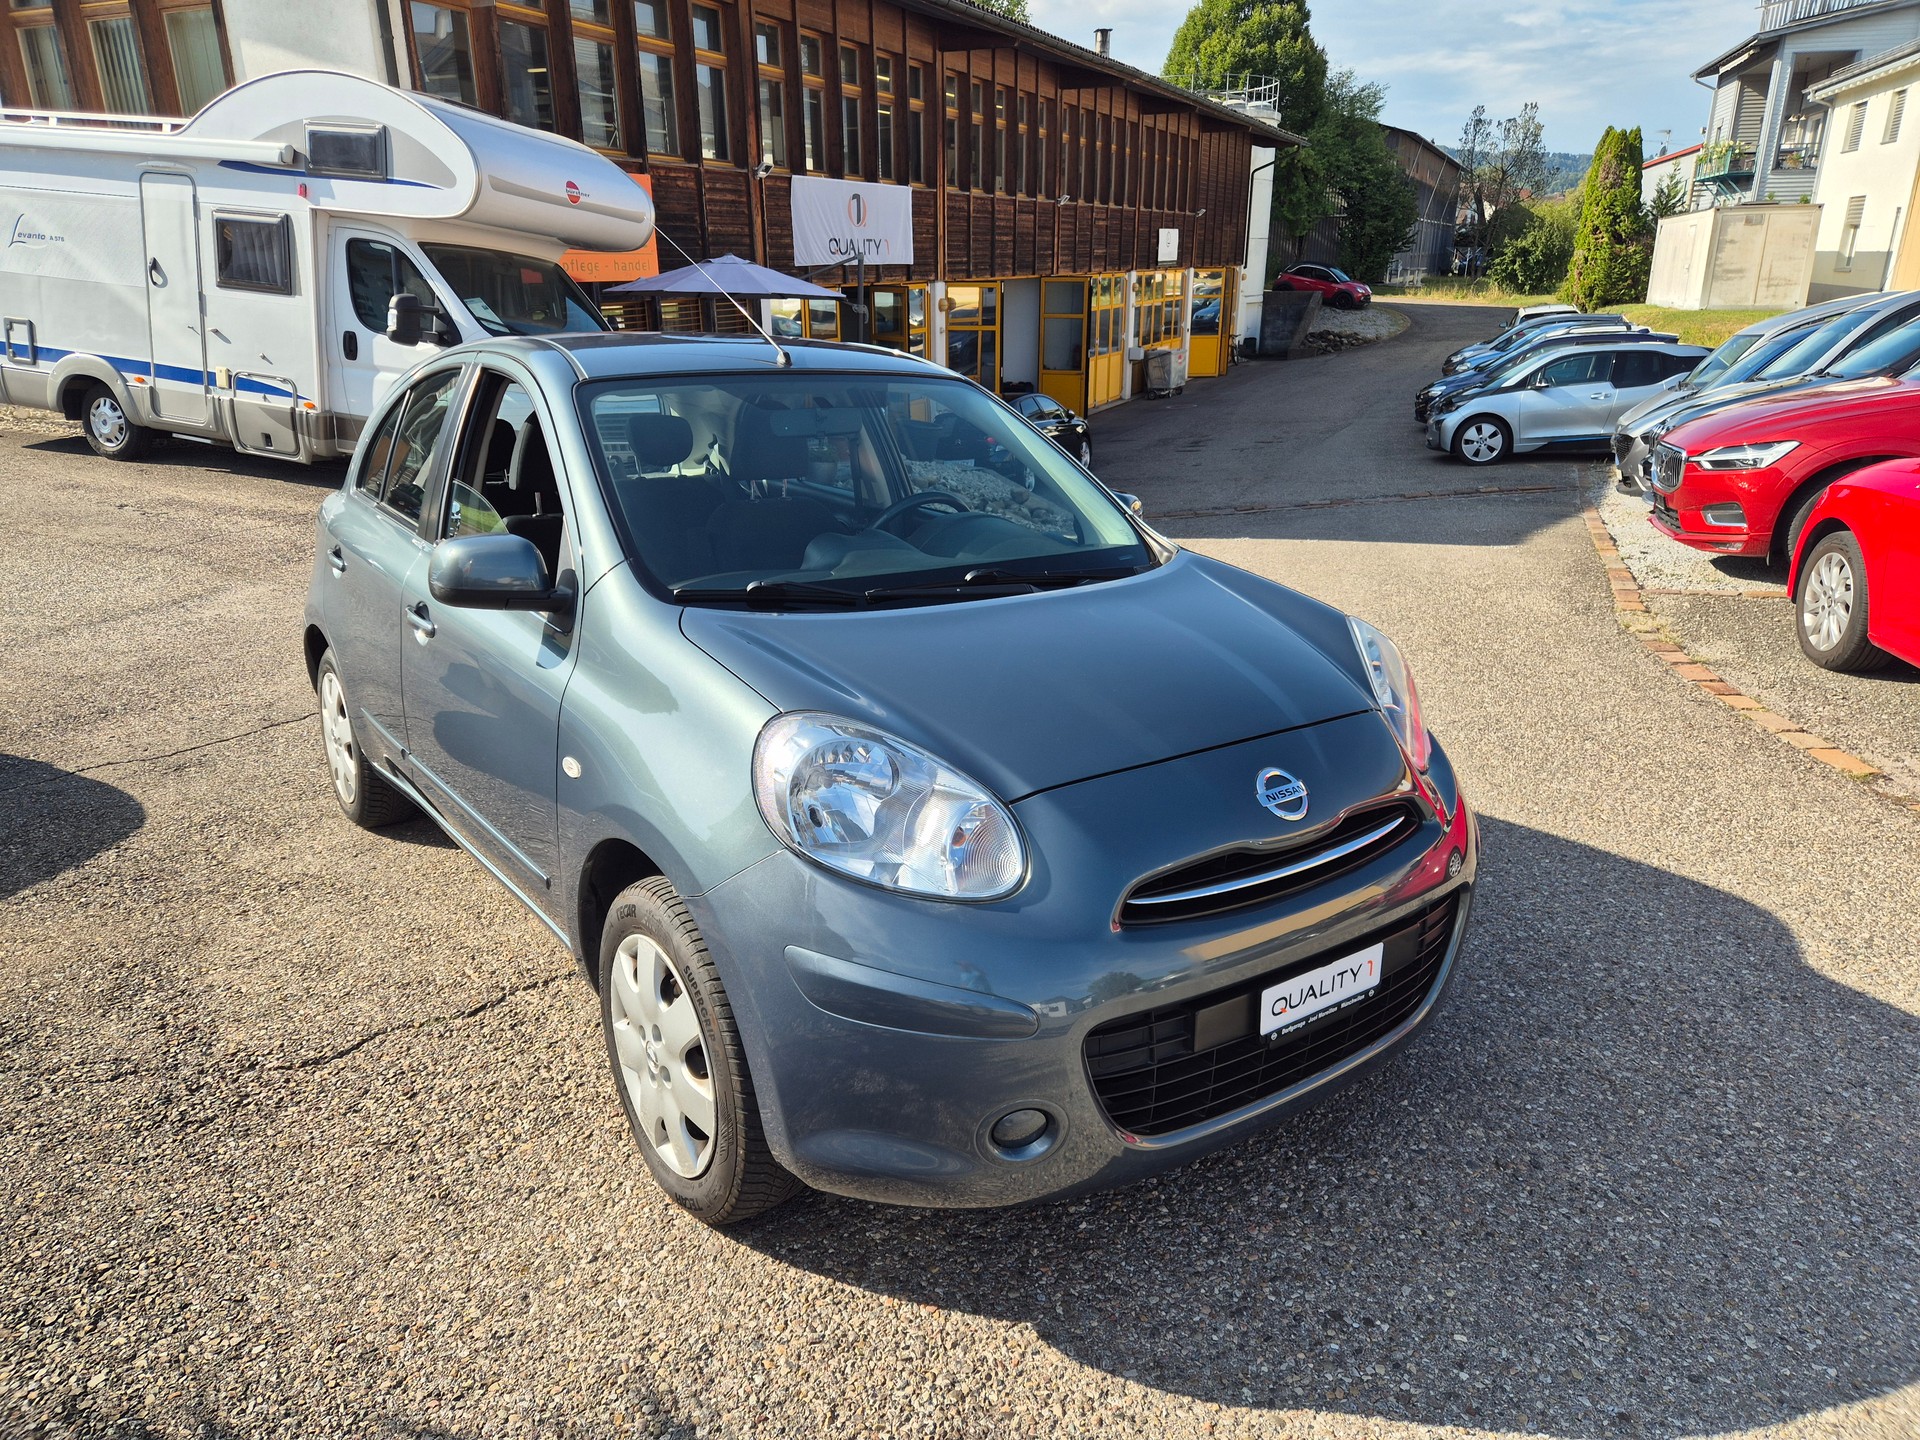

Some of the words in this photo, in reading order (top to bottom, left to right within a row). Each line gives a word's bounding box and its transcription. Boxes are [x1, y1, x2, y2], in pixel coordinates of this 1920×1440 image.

[8, 213, 46, 248] Levanto
[828, 237, 882, 257] QUALITY
[884, 239, 890, 256] 1
[613, 258, 651, 272] handel
[1265, 785, 1305, 802] NISSAN
[616, 903, 637, 921] TECAR
[1271, 963, 1363, 1016] QUALITY
[1367, 960, 1373, 977] 1
[683, 964, 716, 1042] SUPERGRIP
